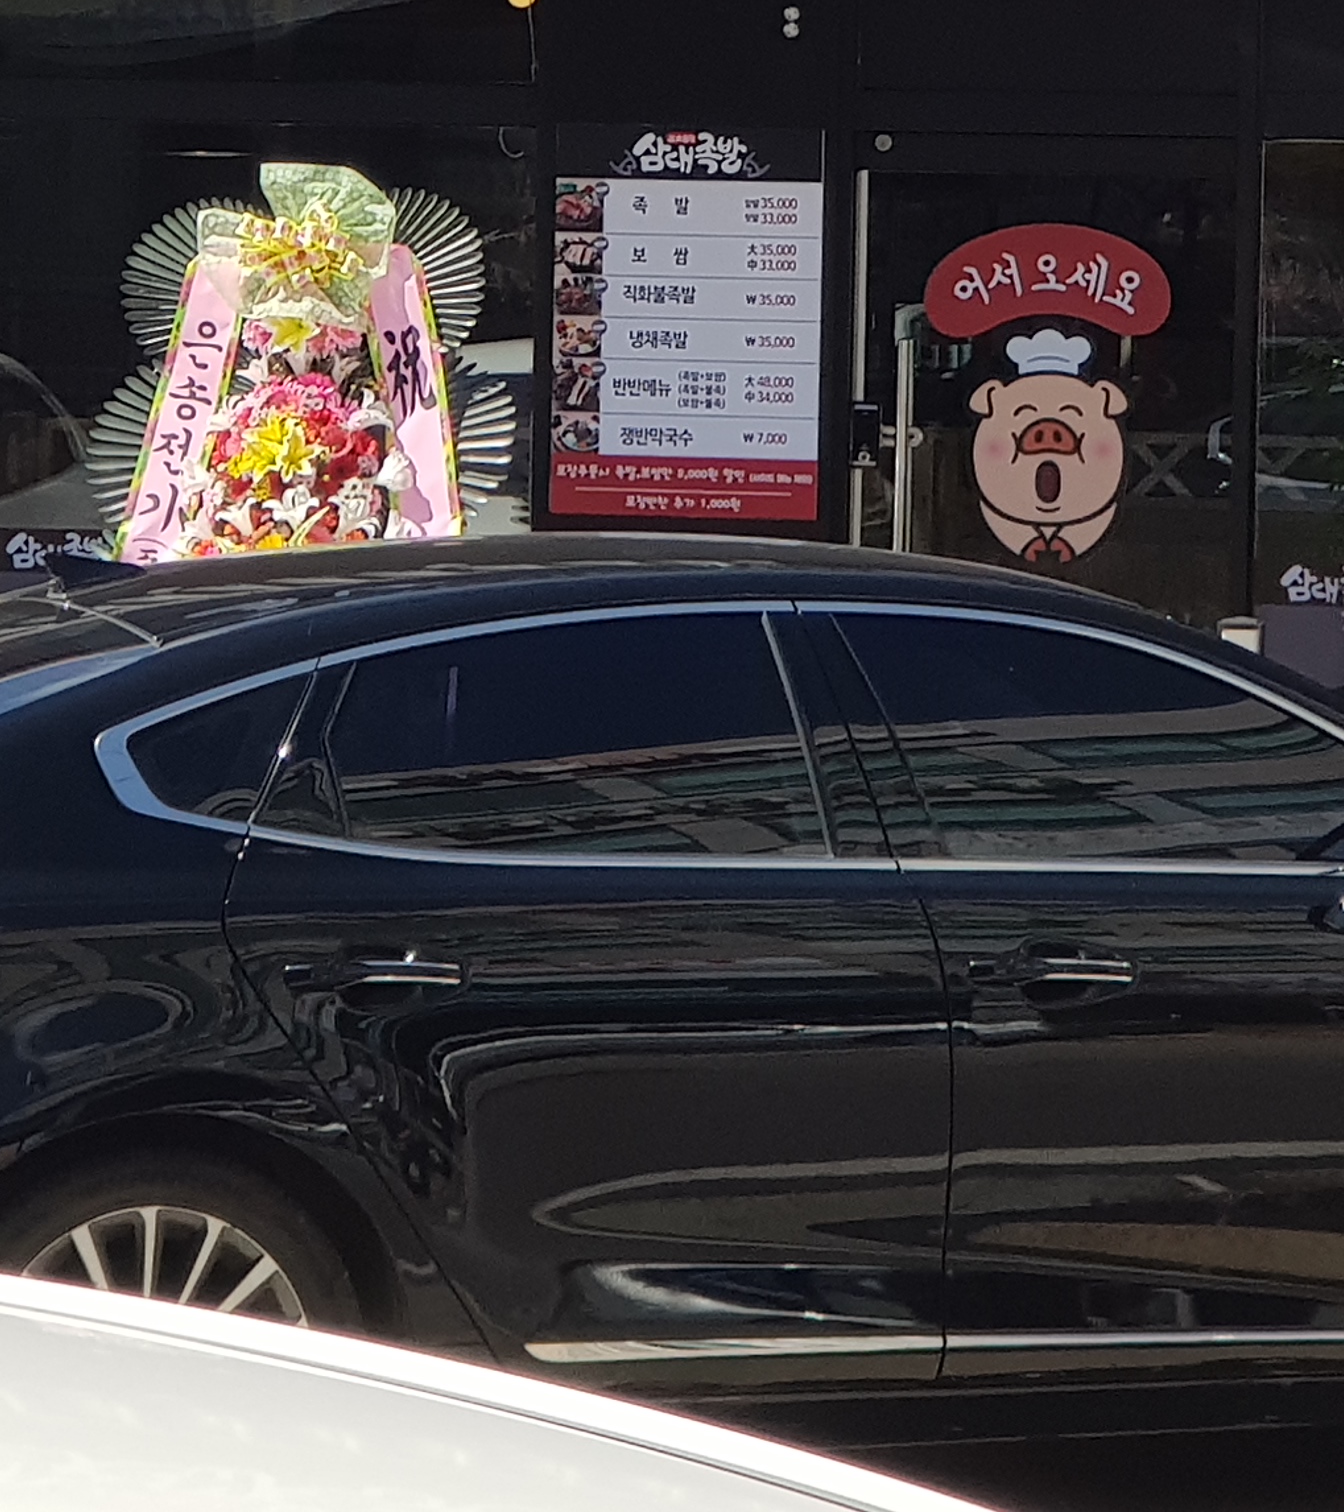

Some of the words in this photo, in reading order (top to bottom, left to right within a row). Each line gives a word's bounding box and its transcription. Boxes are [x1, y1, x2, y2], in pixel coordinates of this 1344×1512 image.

[632, 132, 748, 174] 삼대족발
[953, 251, 1022, 306] 어서
[1031, 252, 1141, 316] 오세요
[622, 285, 696, 304] 직화불족발
[629, 331, 688, 349] 냉채족발
[383, 324, 437, 418] 祝
[612, 377, 672, 397] 반반메뉴
[620, 427, 694, 447] 쟁반막국수
